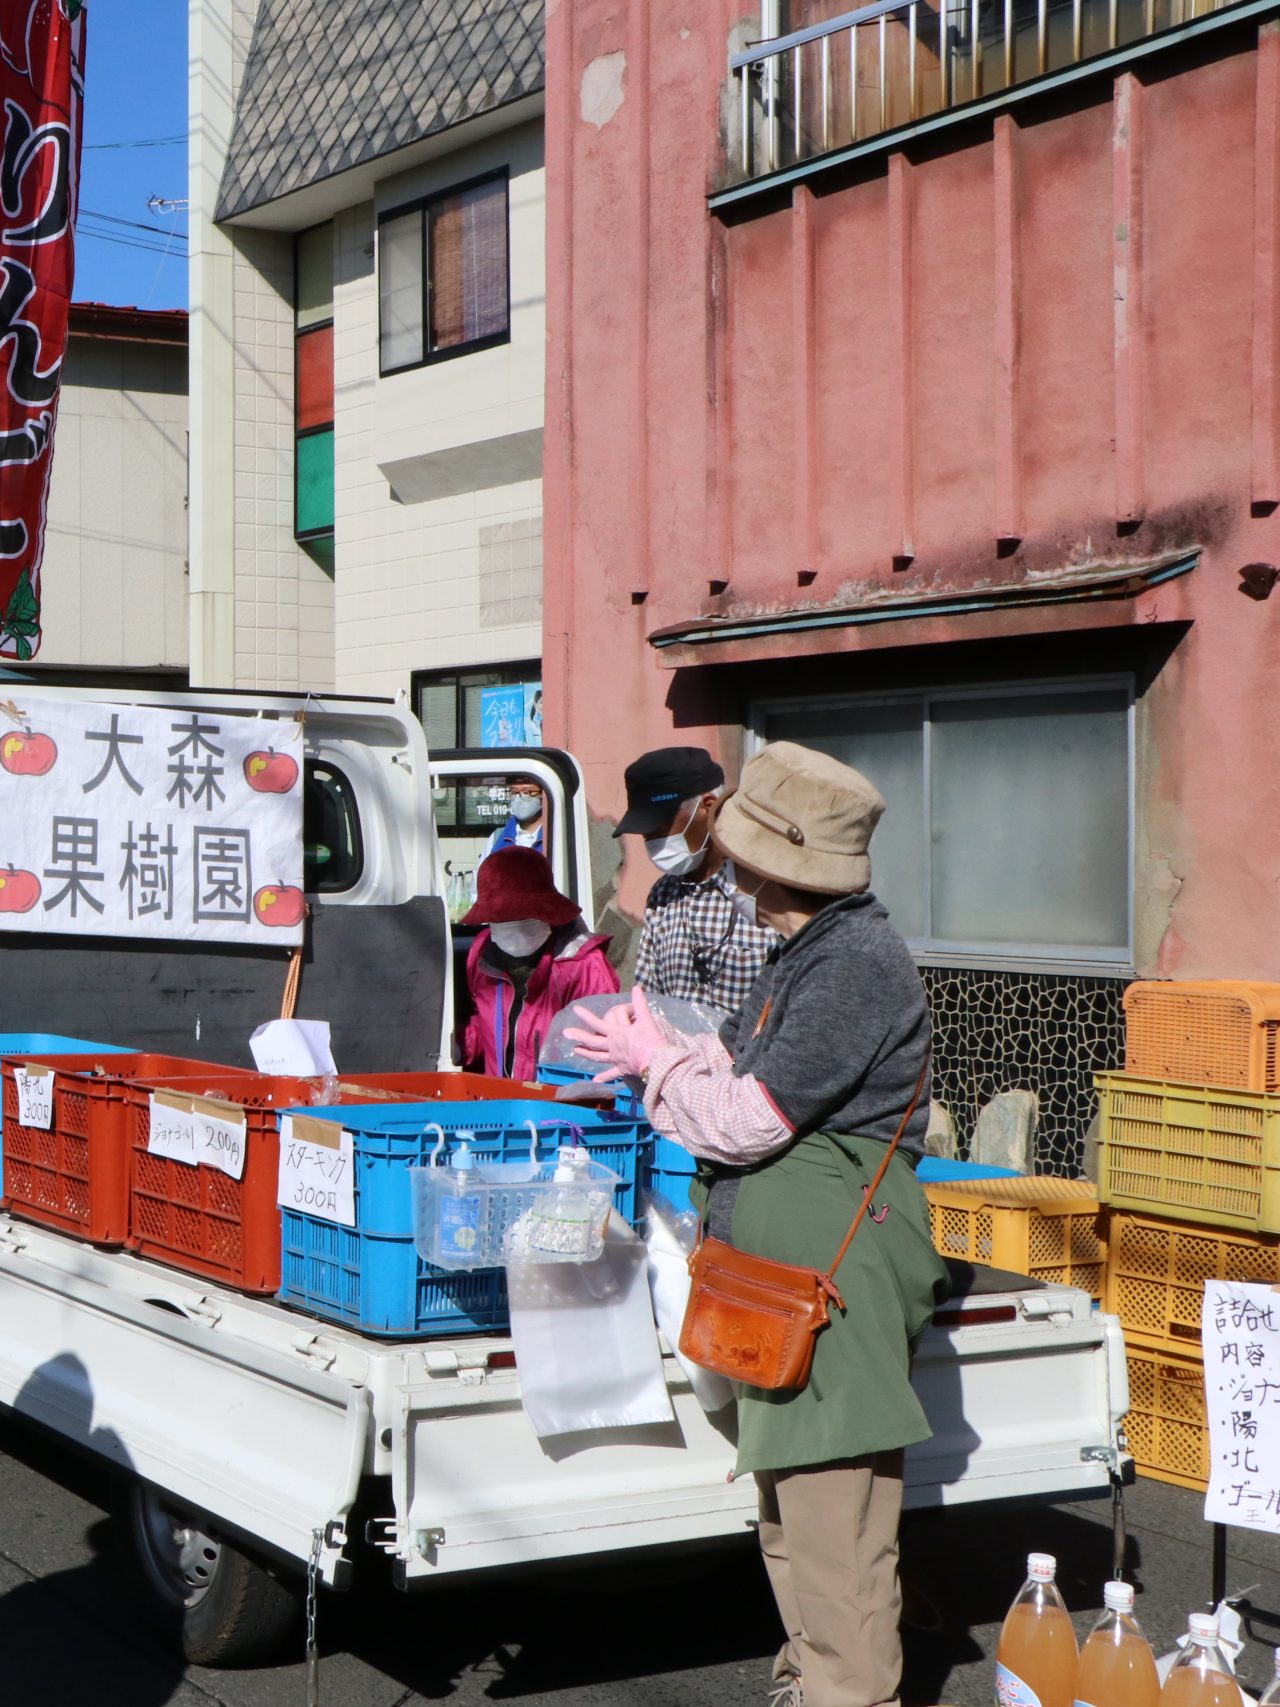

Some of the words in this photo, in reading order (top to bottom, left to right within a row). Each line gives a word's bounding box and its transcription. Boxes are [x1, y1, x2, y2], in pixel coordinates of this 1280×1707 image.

[81, 712, 227, 812] 大森
[477, 805, 492, 816] TEL
[493, 805, 514, 816] 019-
[42, 815, 253, 925] 果樹園
[23, 1100, 49, 1127] 300円
[205, 1125, 240, 1166] 200円
[293, 1182, 337, 1213] 300円
[1213, 1292, 1279, 1334] 詰合せ
[1220, 1341, 1266, 1368] 内容
